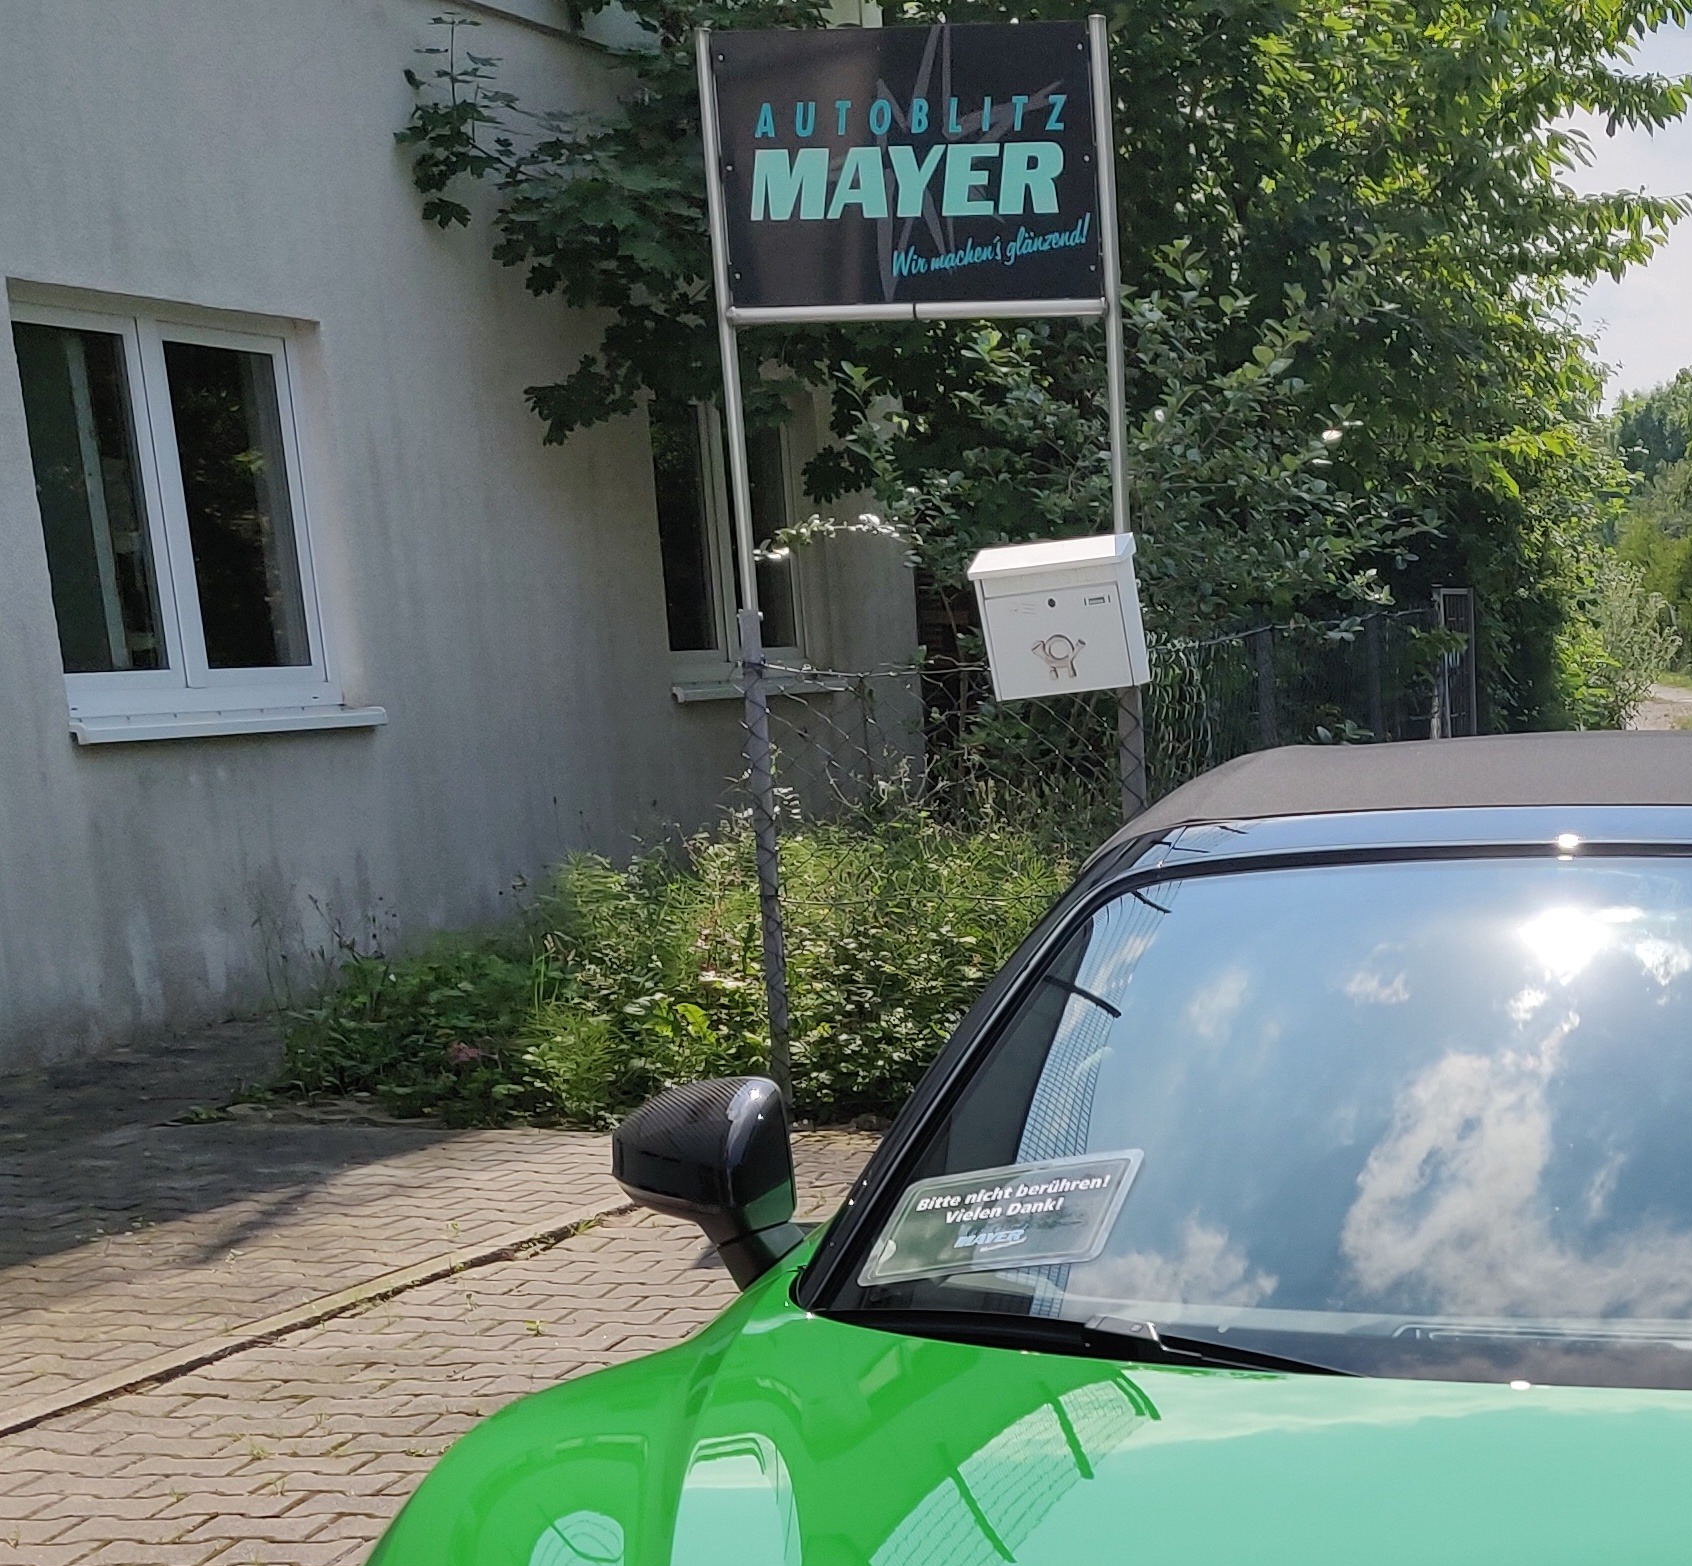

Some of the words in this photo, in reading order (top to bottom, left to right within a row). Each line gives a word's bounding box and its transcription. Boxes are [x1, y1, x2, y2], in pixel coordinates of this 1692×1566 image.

[754, 94, 1068, 138] AUTOBLITZ
[750, 141, 1065, 222] MAYER
[892, 245, 928, 277] Wir
[1004, 212, 1091, 266] glänzend!
[915, 1196, 961, 1212] Bitte
[965, 1186, 1013, 1206] nicht
[1015, 1175, 1112, 1198] berühren!
[946, 1205, 1002, 1224] Vielen
[1006, 1197, 1065, 1217] Dank!
[954, 1229, 1025, 1248] MAYER
